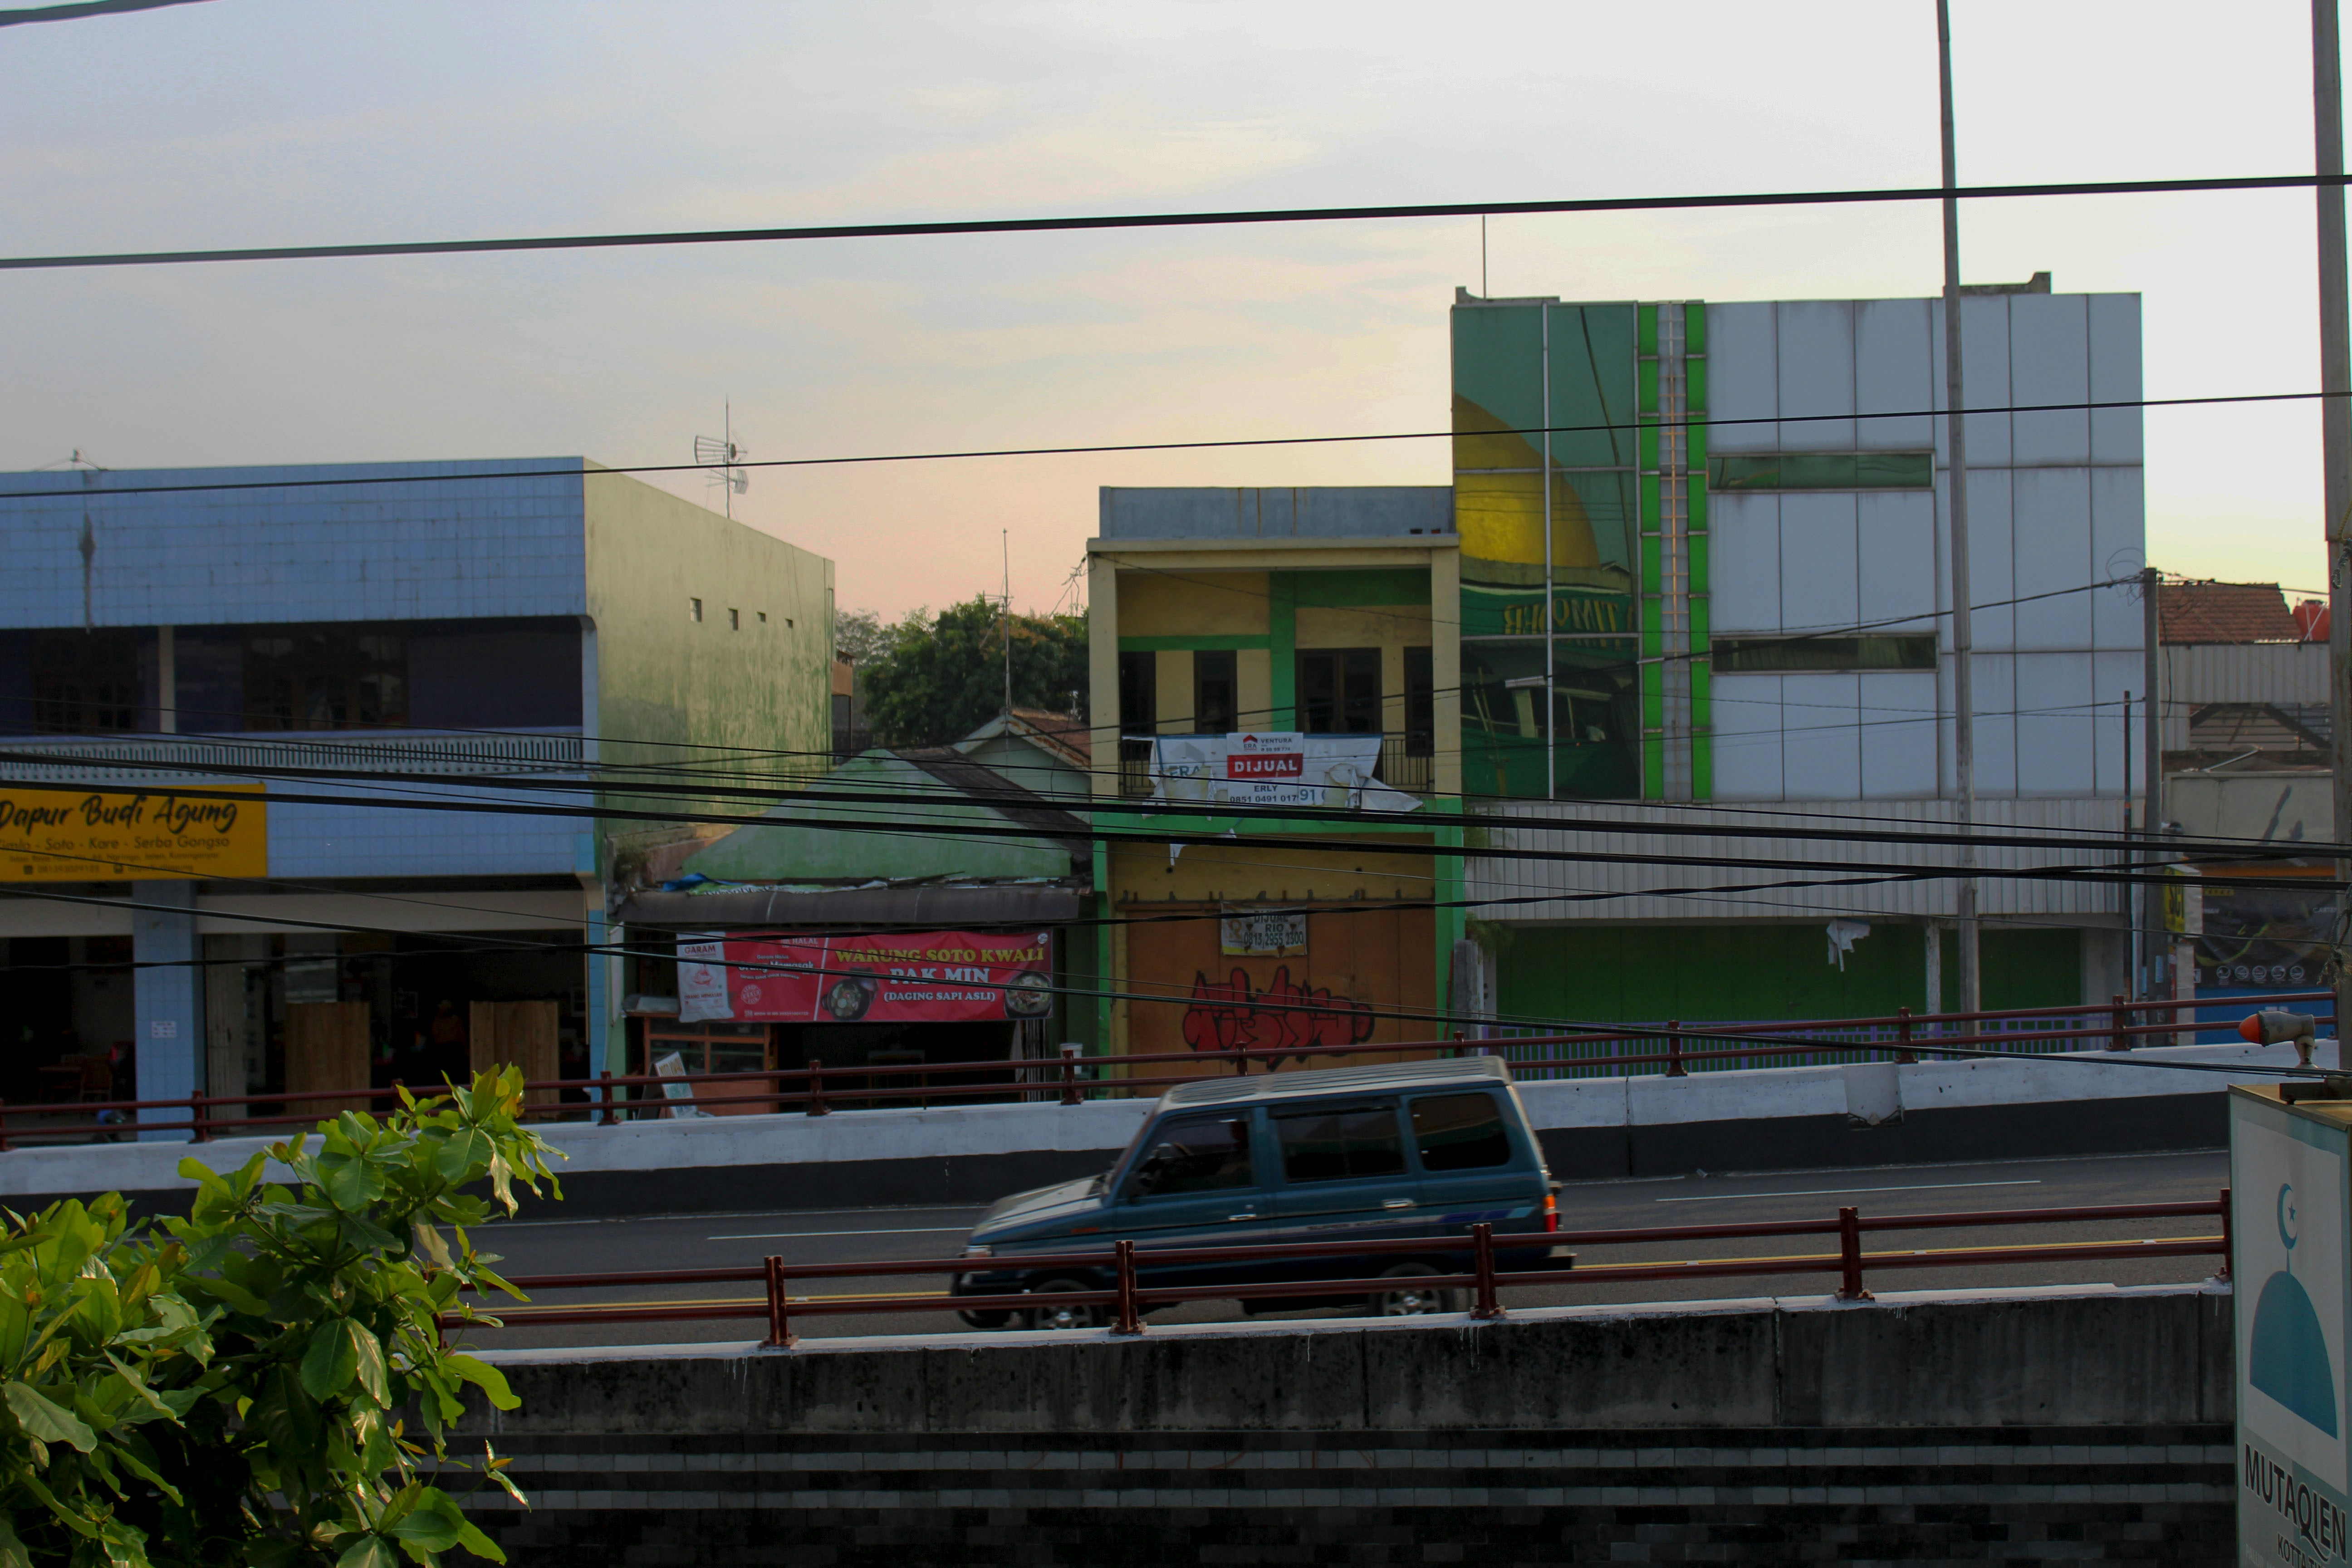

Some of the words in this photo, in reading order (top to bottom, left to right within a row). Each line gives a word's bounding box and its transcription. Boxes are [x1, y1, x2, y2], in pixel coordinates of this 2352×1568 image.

[1234, 760, 1298, 773] DIJUAL
[0, 800, 73, 836] Dapur
[80, 794, 147, 830] Budi
[153, 795, 237, 834] Agung
[45, 838, 74, 850] Soto
[88, 837, 119, 849] Kare
[134, 836, 172, 848] Serba
[176, 835, 229, 850] Gongso
[1265, 924, 1284, 932] RIO
[684, 945, 716, 955] GARAM
[835, 950, 922, 963] WARUNG
[926, 949, 976, 962] SOTO
[980, 947, 1044, 962] KWALI
[889, 968, 937, 985] PAK
[944, 967, 990, 984] MIN
[883, 991, 934, 1002] (DAGING
[936, 991, 962, 1000] SAPI
[965, 991, 996, 1002] ASLI)
[2244, 1442, 2347, 1563] MUTAQIEN
[2277, 1531, 2307, 1568] KOTTA
